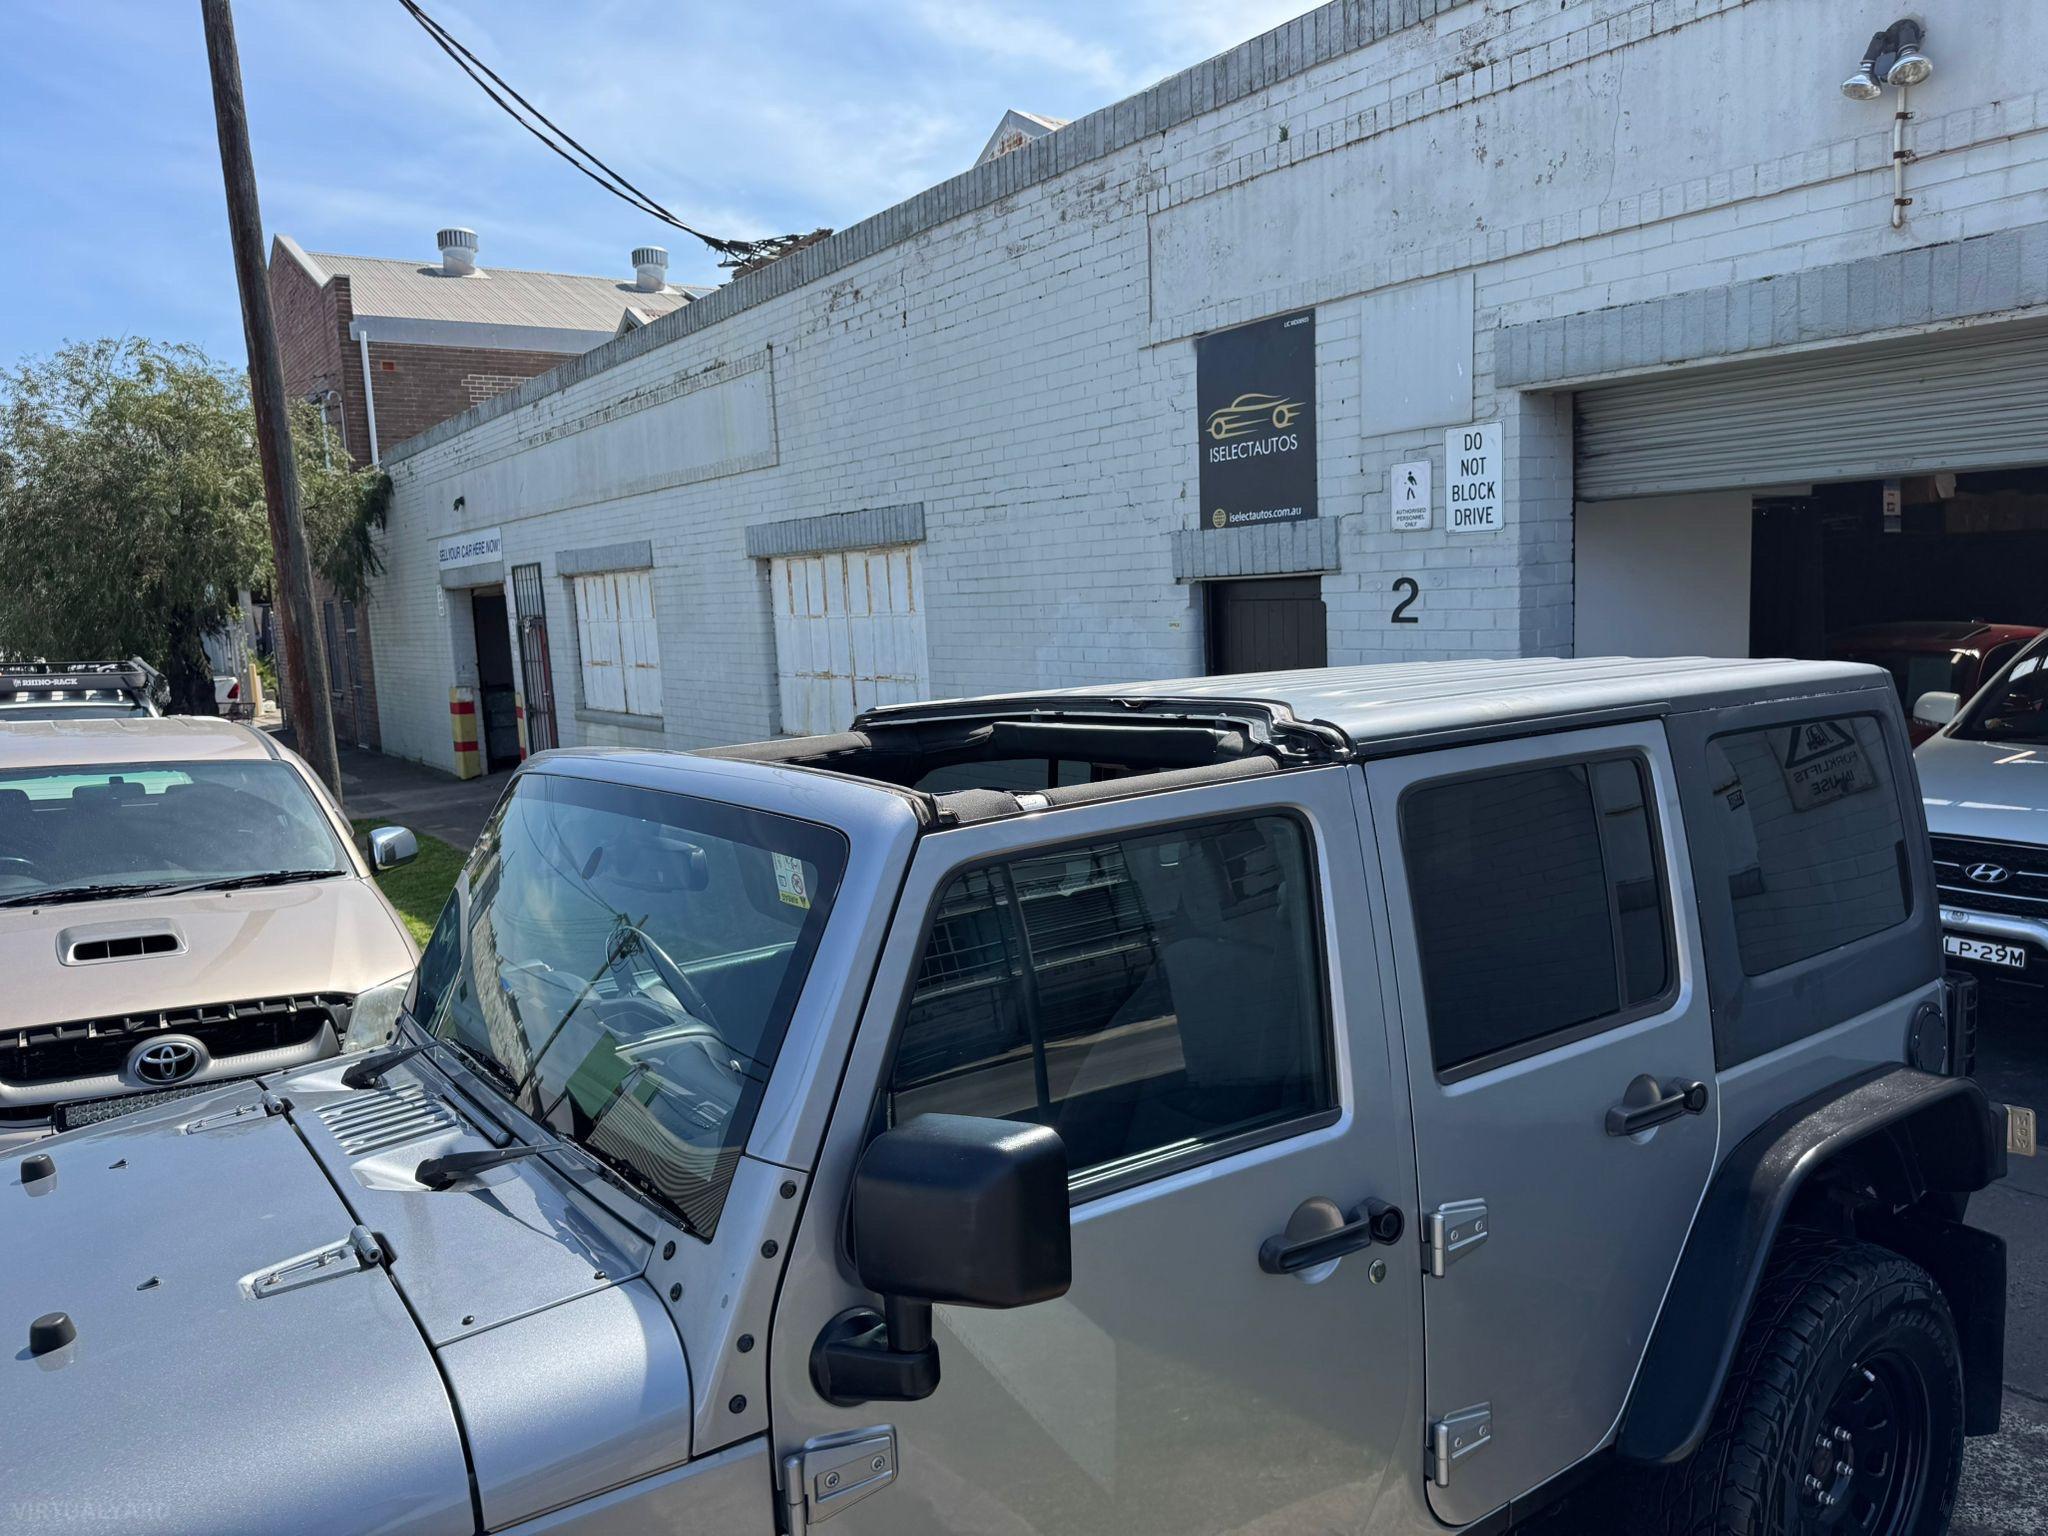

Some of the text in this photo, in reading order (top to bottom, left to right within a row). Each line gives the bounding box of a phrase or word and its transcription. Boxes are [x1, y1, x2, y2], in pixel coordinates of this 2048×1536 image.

[1209, 434, 1298, 463] ISELECTAUTOS
[1464, 432, 1482, 451] DO
[1461, 457, 1486, 477] NOT
[1452, 481, 1495, 502] BLOCK
[1229, 507, 1302, 522] iselectautos.com.au
[1454, 506, 1493, 526] DRIVE
[440, 549, 448, 561] SELL
[449, 546, 460, 560] YOUR
[461, 544, 472, 558] CAR
[473, 541, 485, 556] HERE
[1391, 576, 1419, 623] 2
[22, 678, 78, 687] RHINO-RACK
